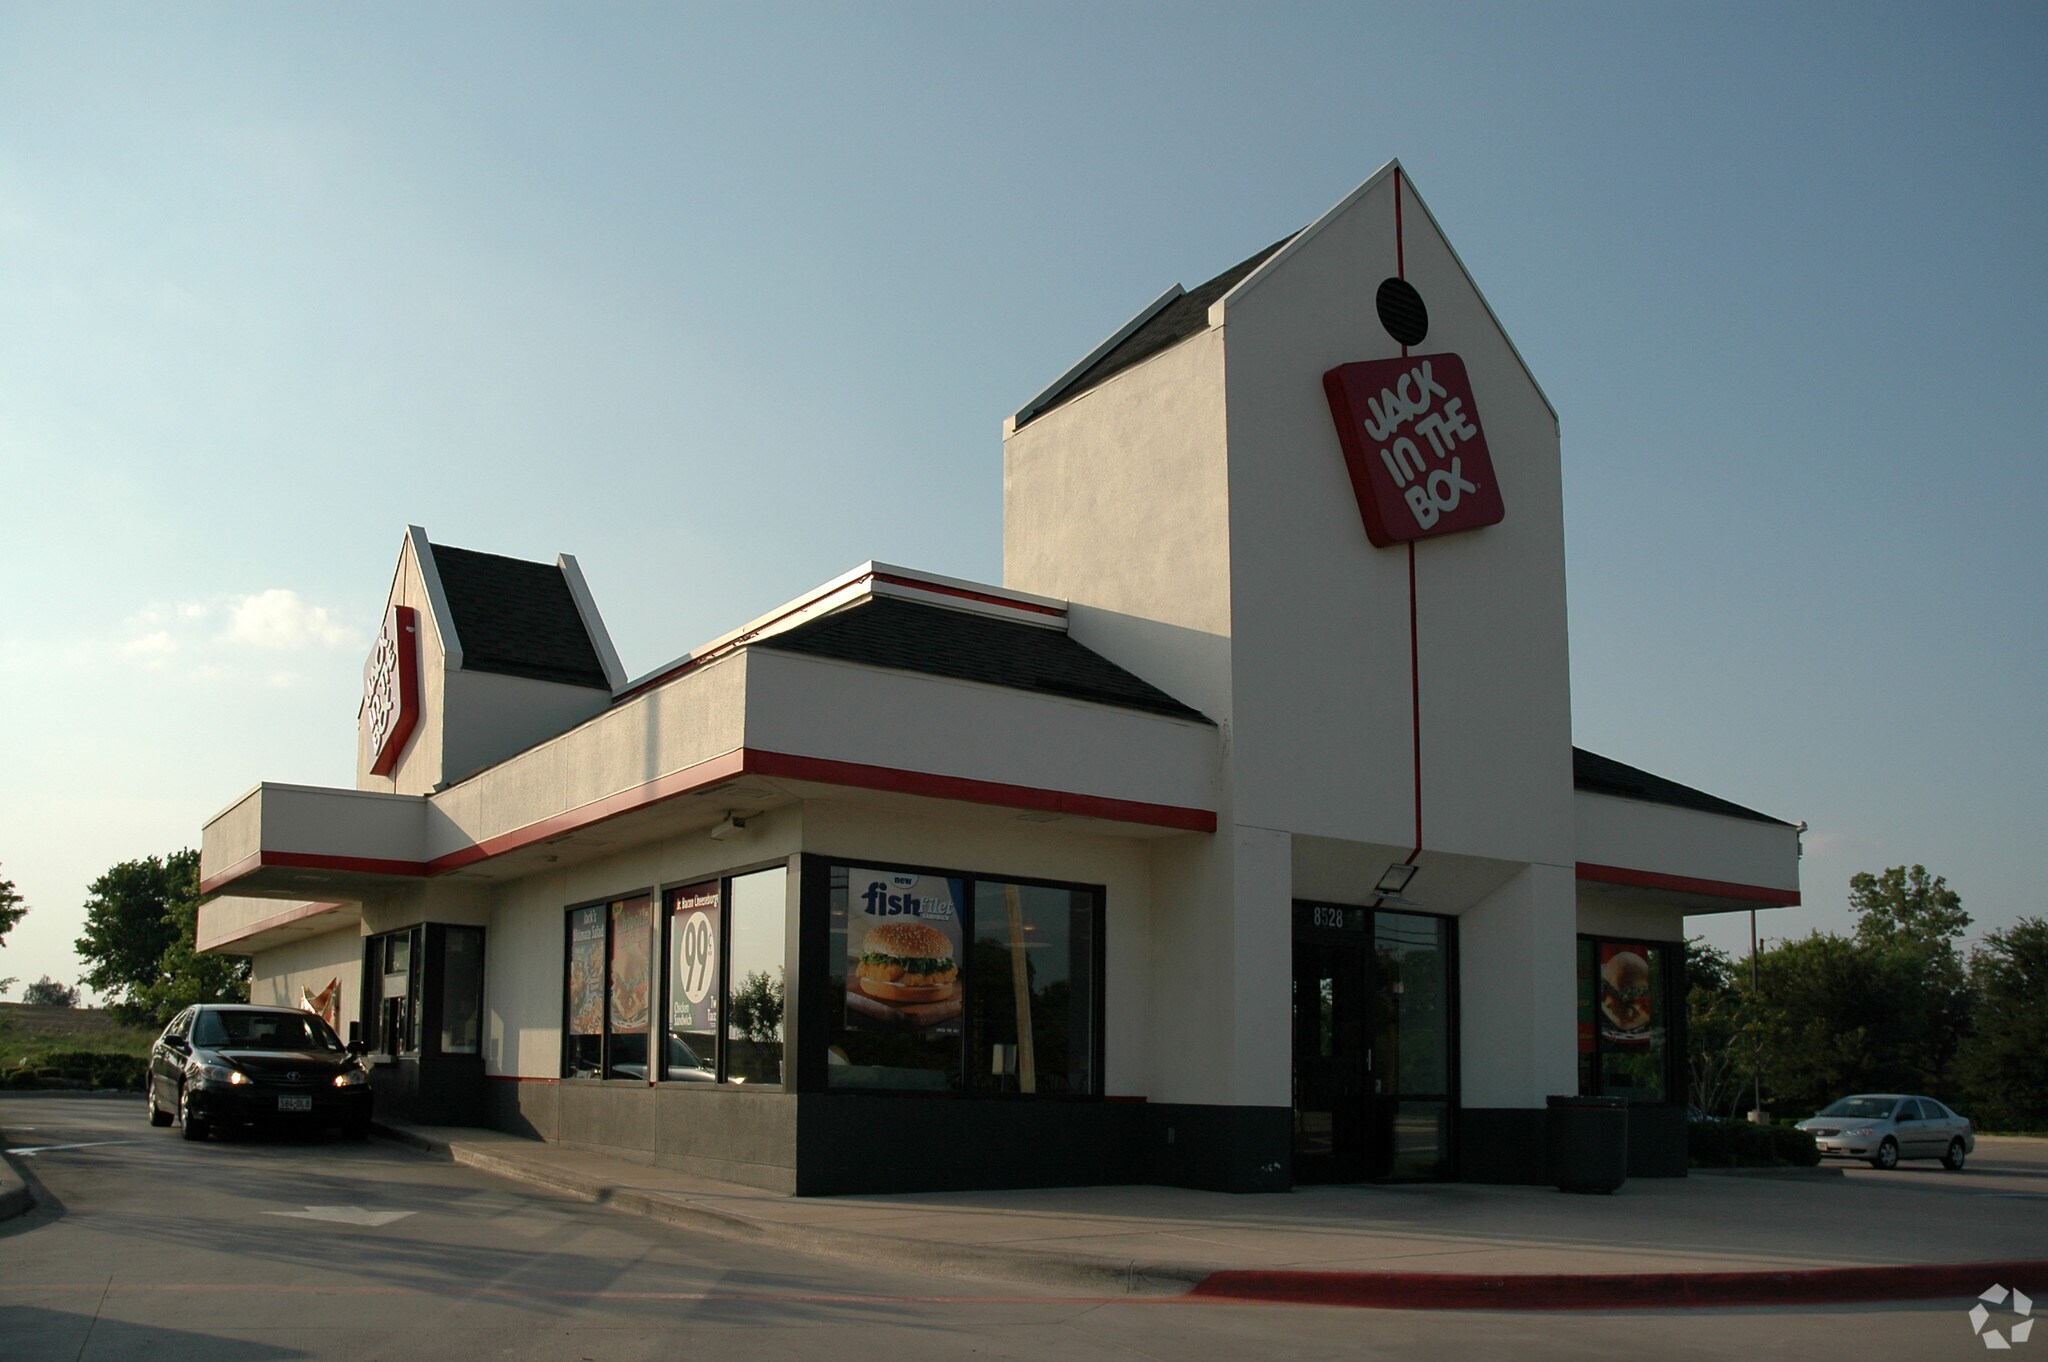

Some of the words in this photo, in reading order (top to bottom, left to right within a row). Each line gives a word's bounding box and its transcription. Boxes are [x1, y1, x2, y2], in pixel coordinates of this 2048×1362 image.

[1364, 360, 1447, 442] JACK
[1414, 397, 1477, 458] THE
[1404, 456, 1476, 530] BOX
[861, 881, 920, 917] fish
[894, 877, 912, 885] new
[682, 896, 694, 909] Bacon
[1314, 906, 1343, 929] 8528
